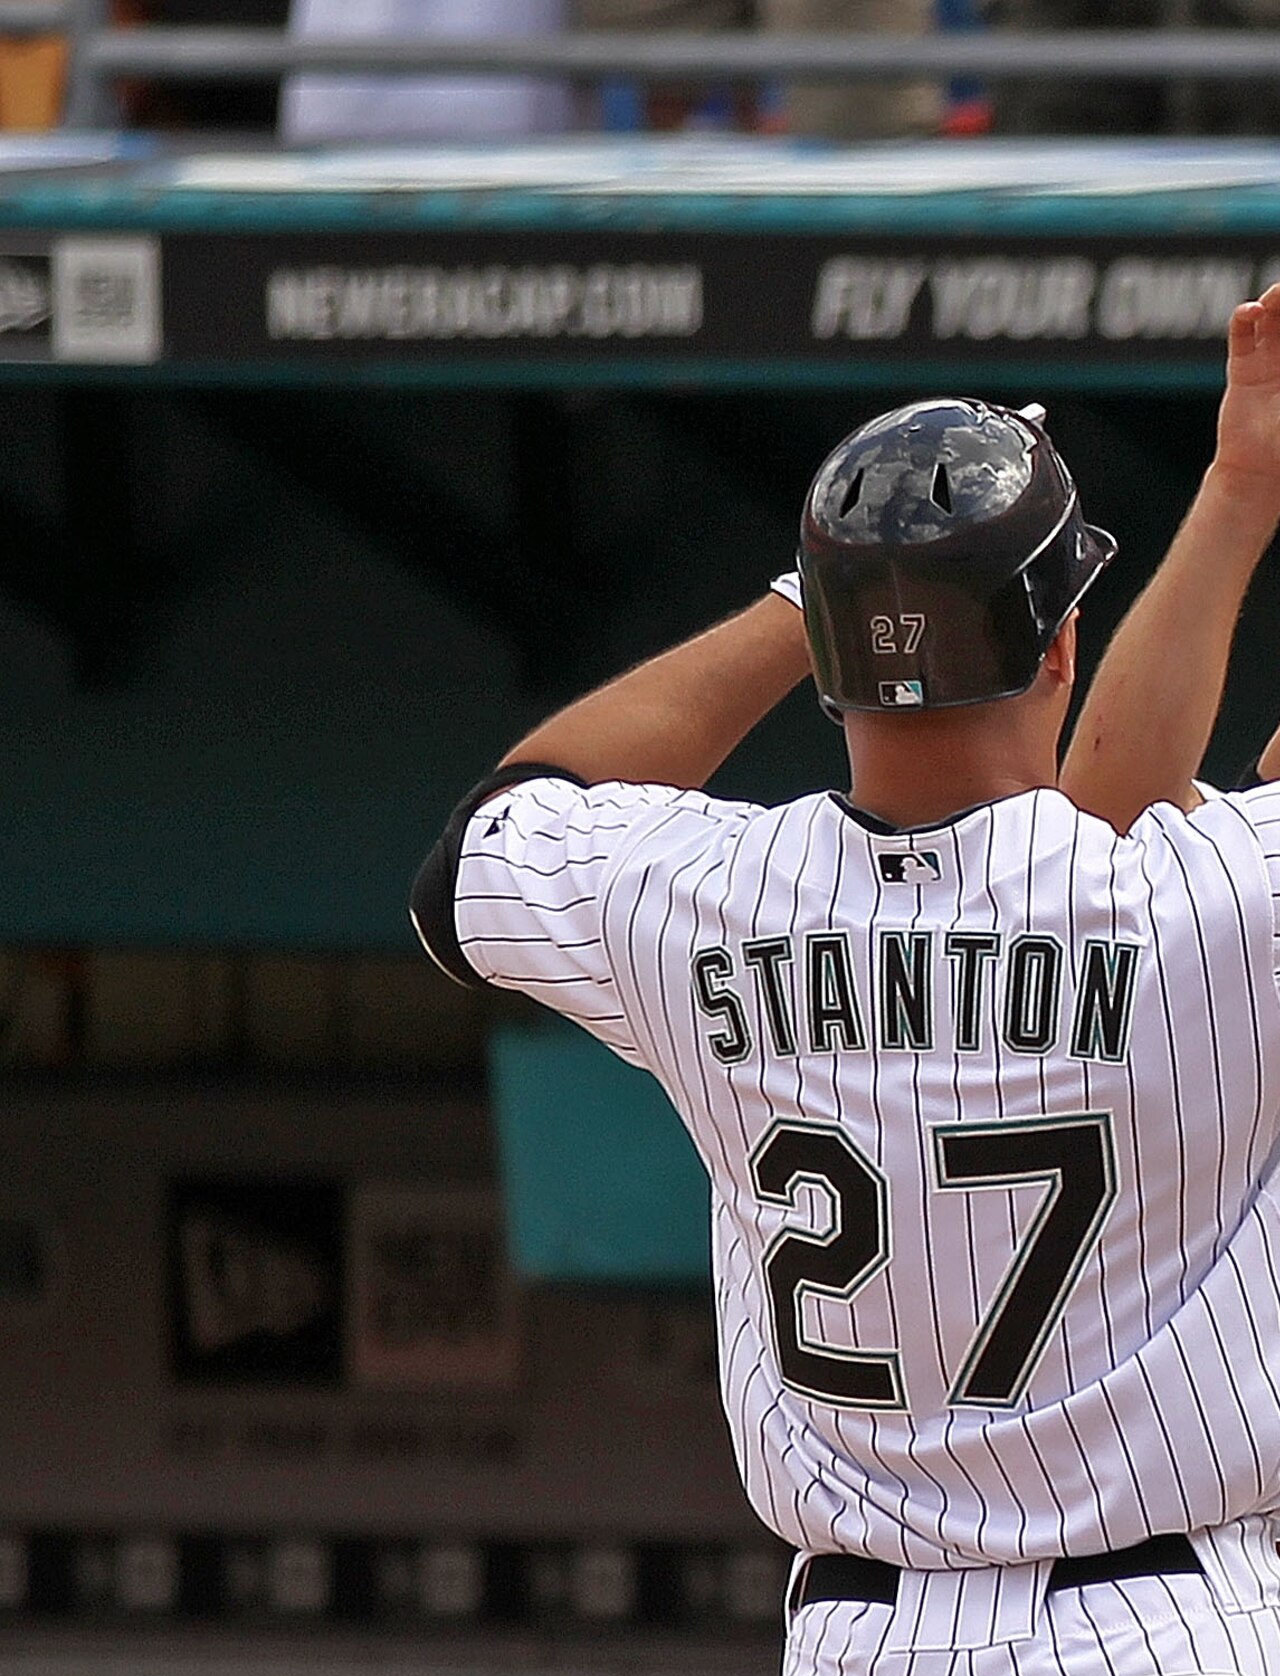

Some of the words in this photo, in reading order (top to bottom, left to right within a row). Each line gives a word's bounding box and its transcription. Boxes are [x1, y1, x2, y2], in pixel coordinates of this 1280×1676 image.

[811, 255, 926, 340] FLY
[930, 255, 1098, 340] YOUR
[870, 613, 926, 654] 27
[690, 928, 1143, 1067] STANTON
[747, 1107, 1120, 1413] 27
